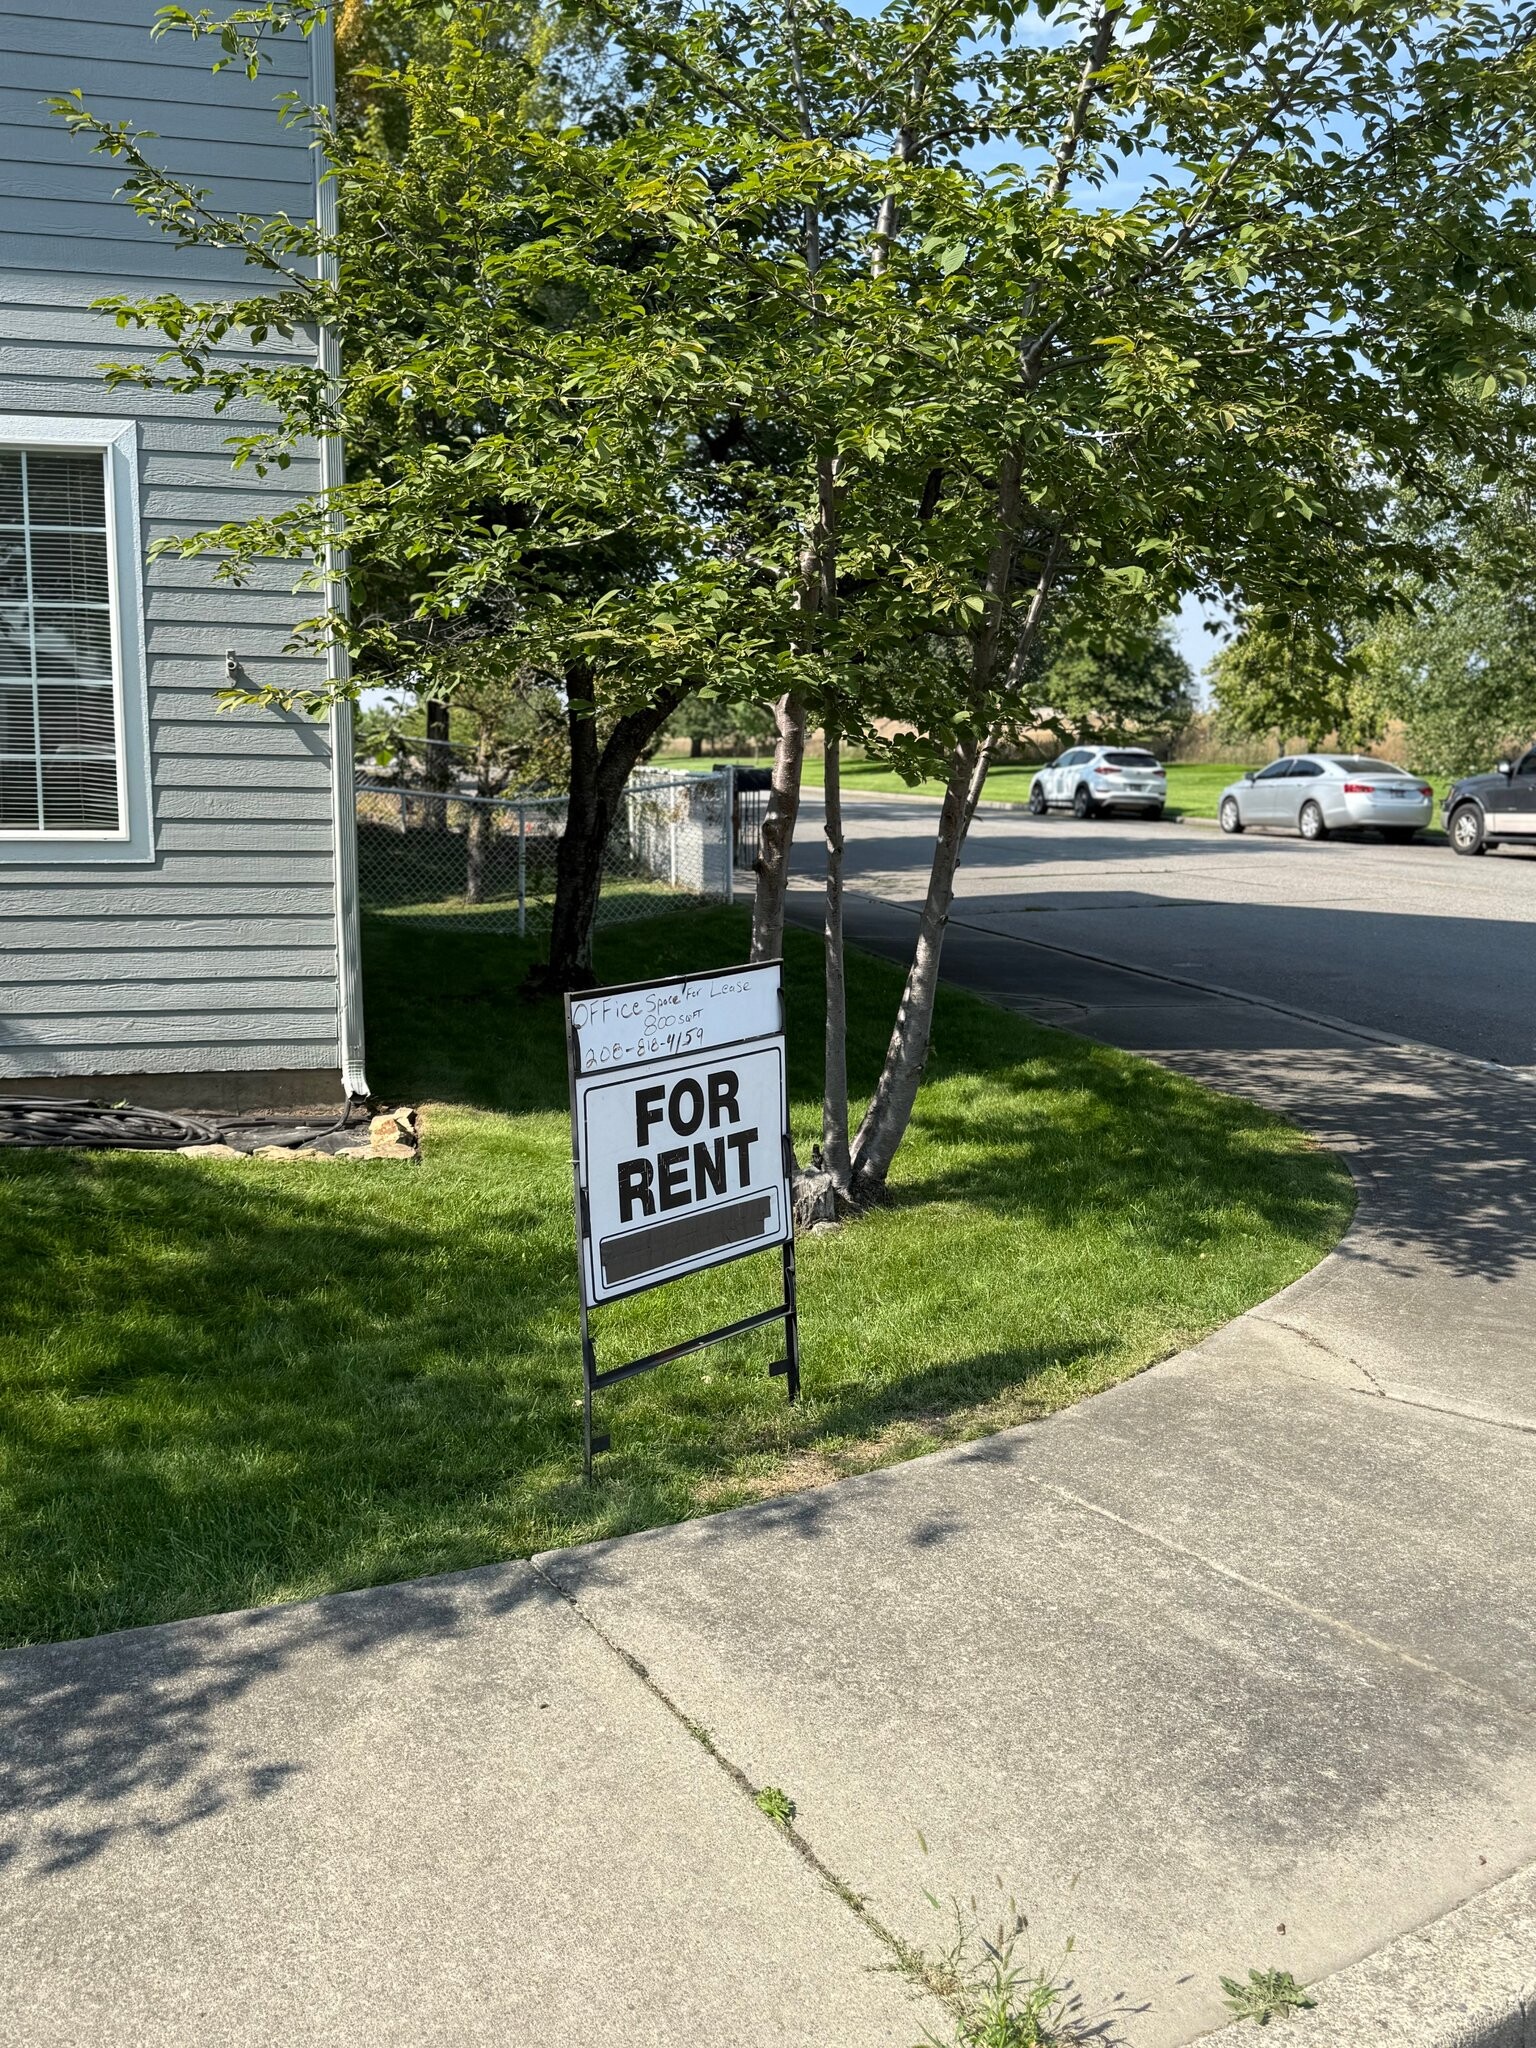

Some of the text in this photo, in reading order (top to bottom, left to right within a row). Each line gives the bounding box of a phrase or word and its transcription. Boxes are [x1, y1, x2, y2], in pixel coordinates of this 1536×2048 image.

[586, 1028, 704, 1068] 208-818-4159
[644, 1014, 676, 1036] 800
[635, 1070, 741, 1147] FOR
[617, 1127, 759, 1224] RENT
